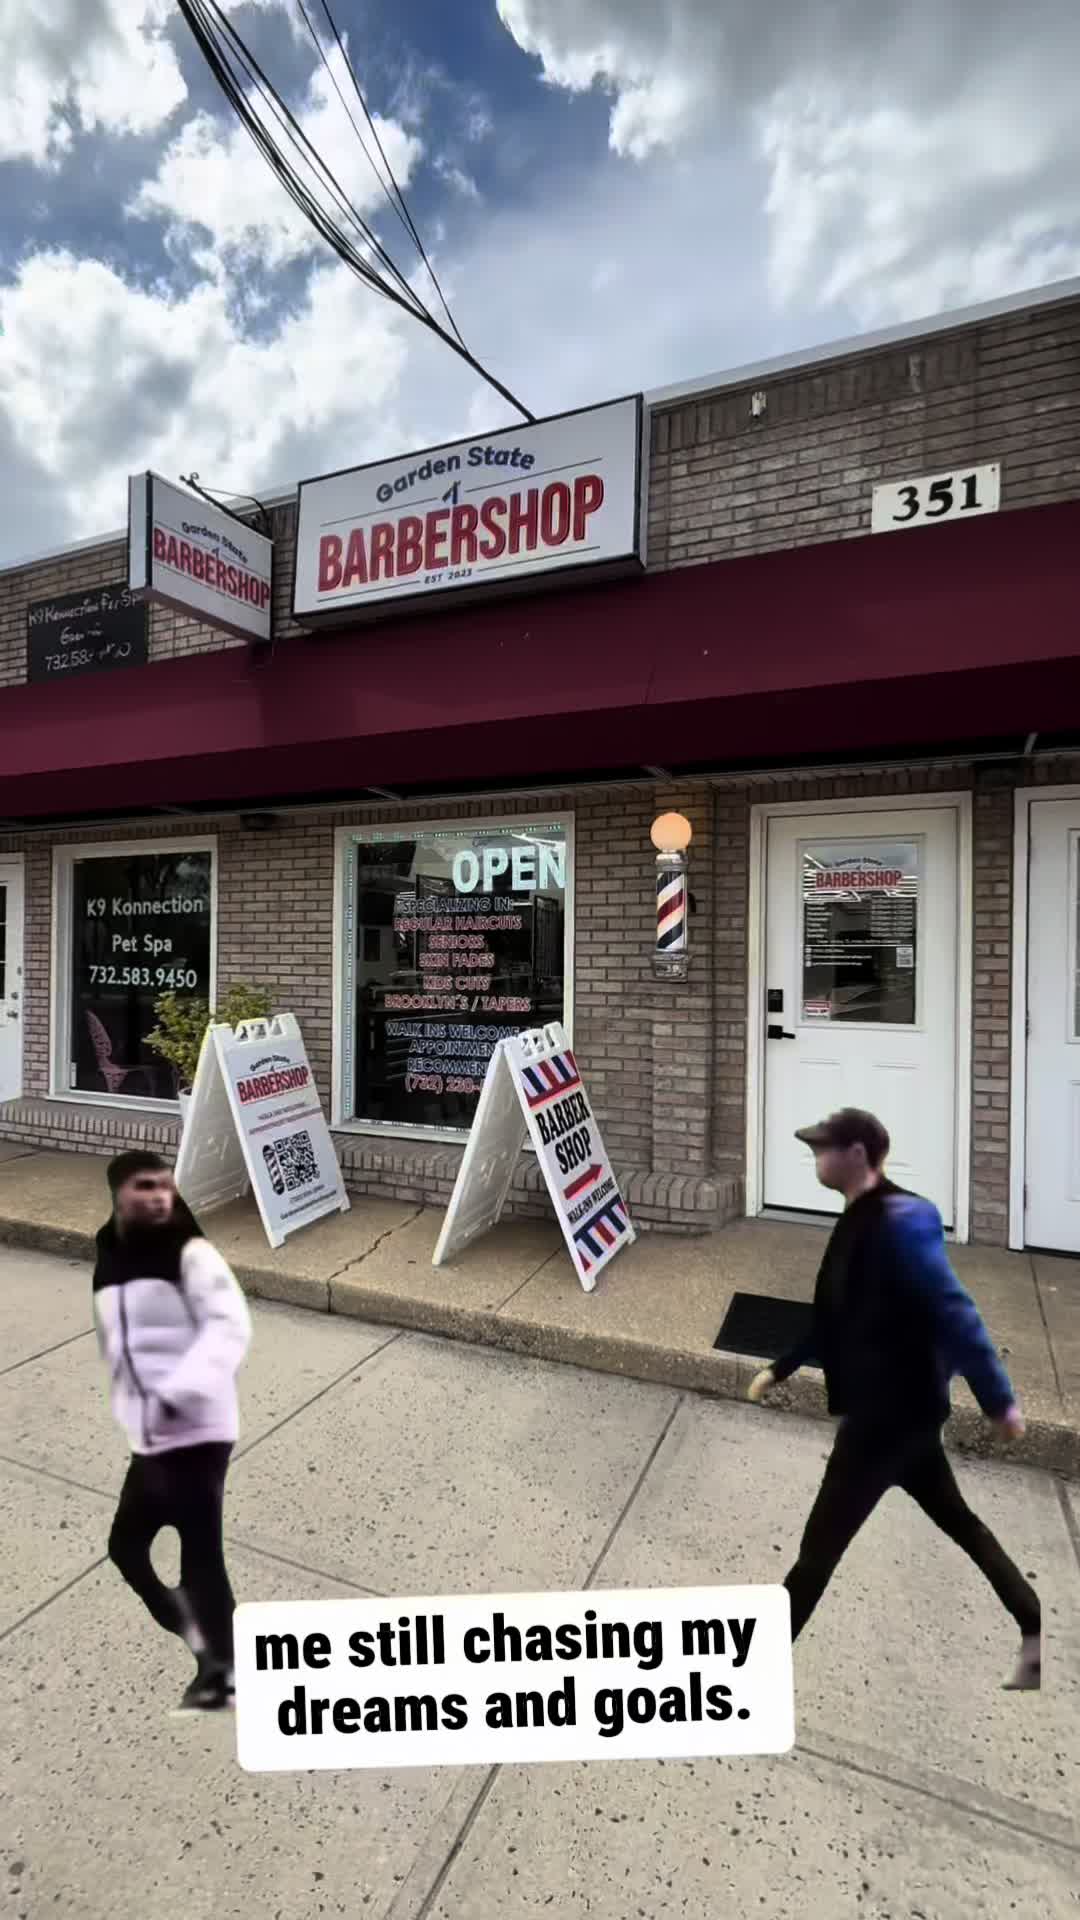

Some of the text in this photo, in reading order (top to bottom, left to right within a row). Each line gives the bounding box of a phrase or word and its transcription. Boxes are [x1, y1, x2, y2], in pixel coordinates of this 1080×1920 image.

[376, 445, 536, 503] Garden State
[892, 473, 982, 521] 351
[181, 522, 248, 564] Garden State
[317, 474, 604, 592] BARBERSHOP
[153, 527, 271, 609] BARBERSHOP
[424, 568, 473, 585] EST 2023
[452, 845, 567, 893] OPEN
[816, 870, 902, 888] BARBERSHOP
[86, 895, 203, 917] K9 Konnection
[403, 896, 514, 914] SPECIALIZING IN:
[393, 915, 522, 932] REGULAR HAIRCUTS
[111, 933, 173, 957] Pet Spa
[428, 934, 484, 949] SENIORS
[418, 952, 495, 968] SKIN FADES
[88, 965, 198, 989] 732.583.9450
[423, 975, 491, 991] KIDS CUTS
[384, 994, 468, 1010] BROOKLYN'S
[481, 996, 531, 1012] TAPERS
[385, 1022, 520, 1041] WALK INS WELCOME
[408, 1039, 496, 1057] APPOINTMEN
[407, 1057, 489, 1075] RECOMMEN
[236, 1065, 309, 1102] BARBERSHOP
[404, 1073, 444, 1095] (732)
[535, 1090, 590, 1146] BARBER
[554, 1125, 593, 1175] SHOP
[566, 1176, 615, 1225] WALK-INS WELCOME
